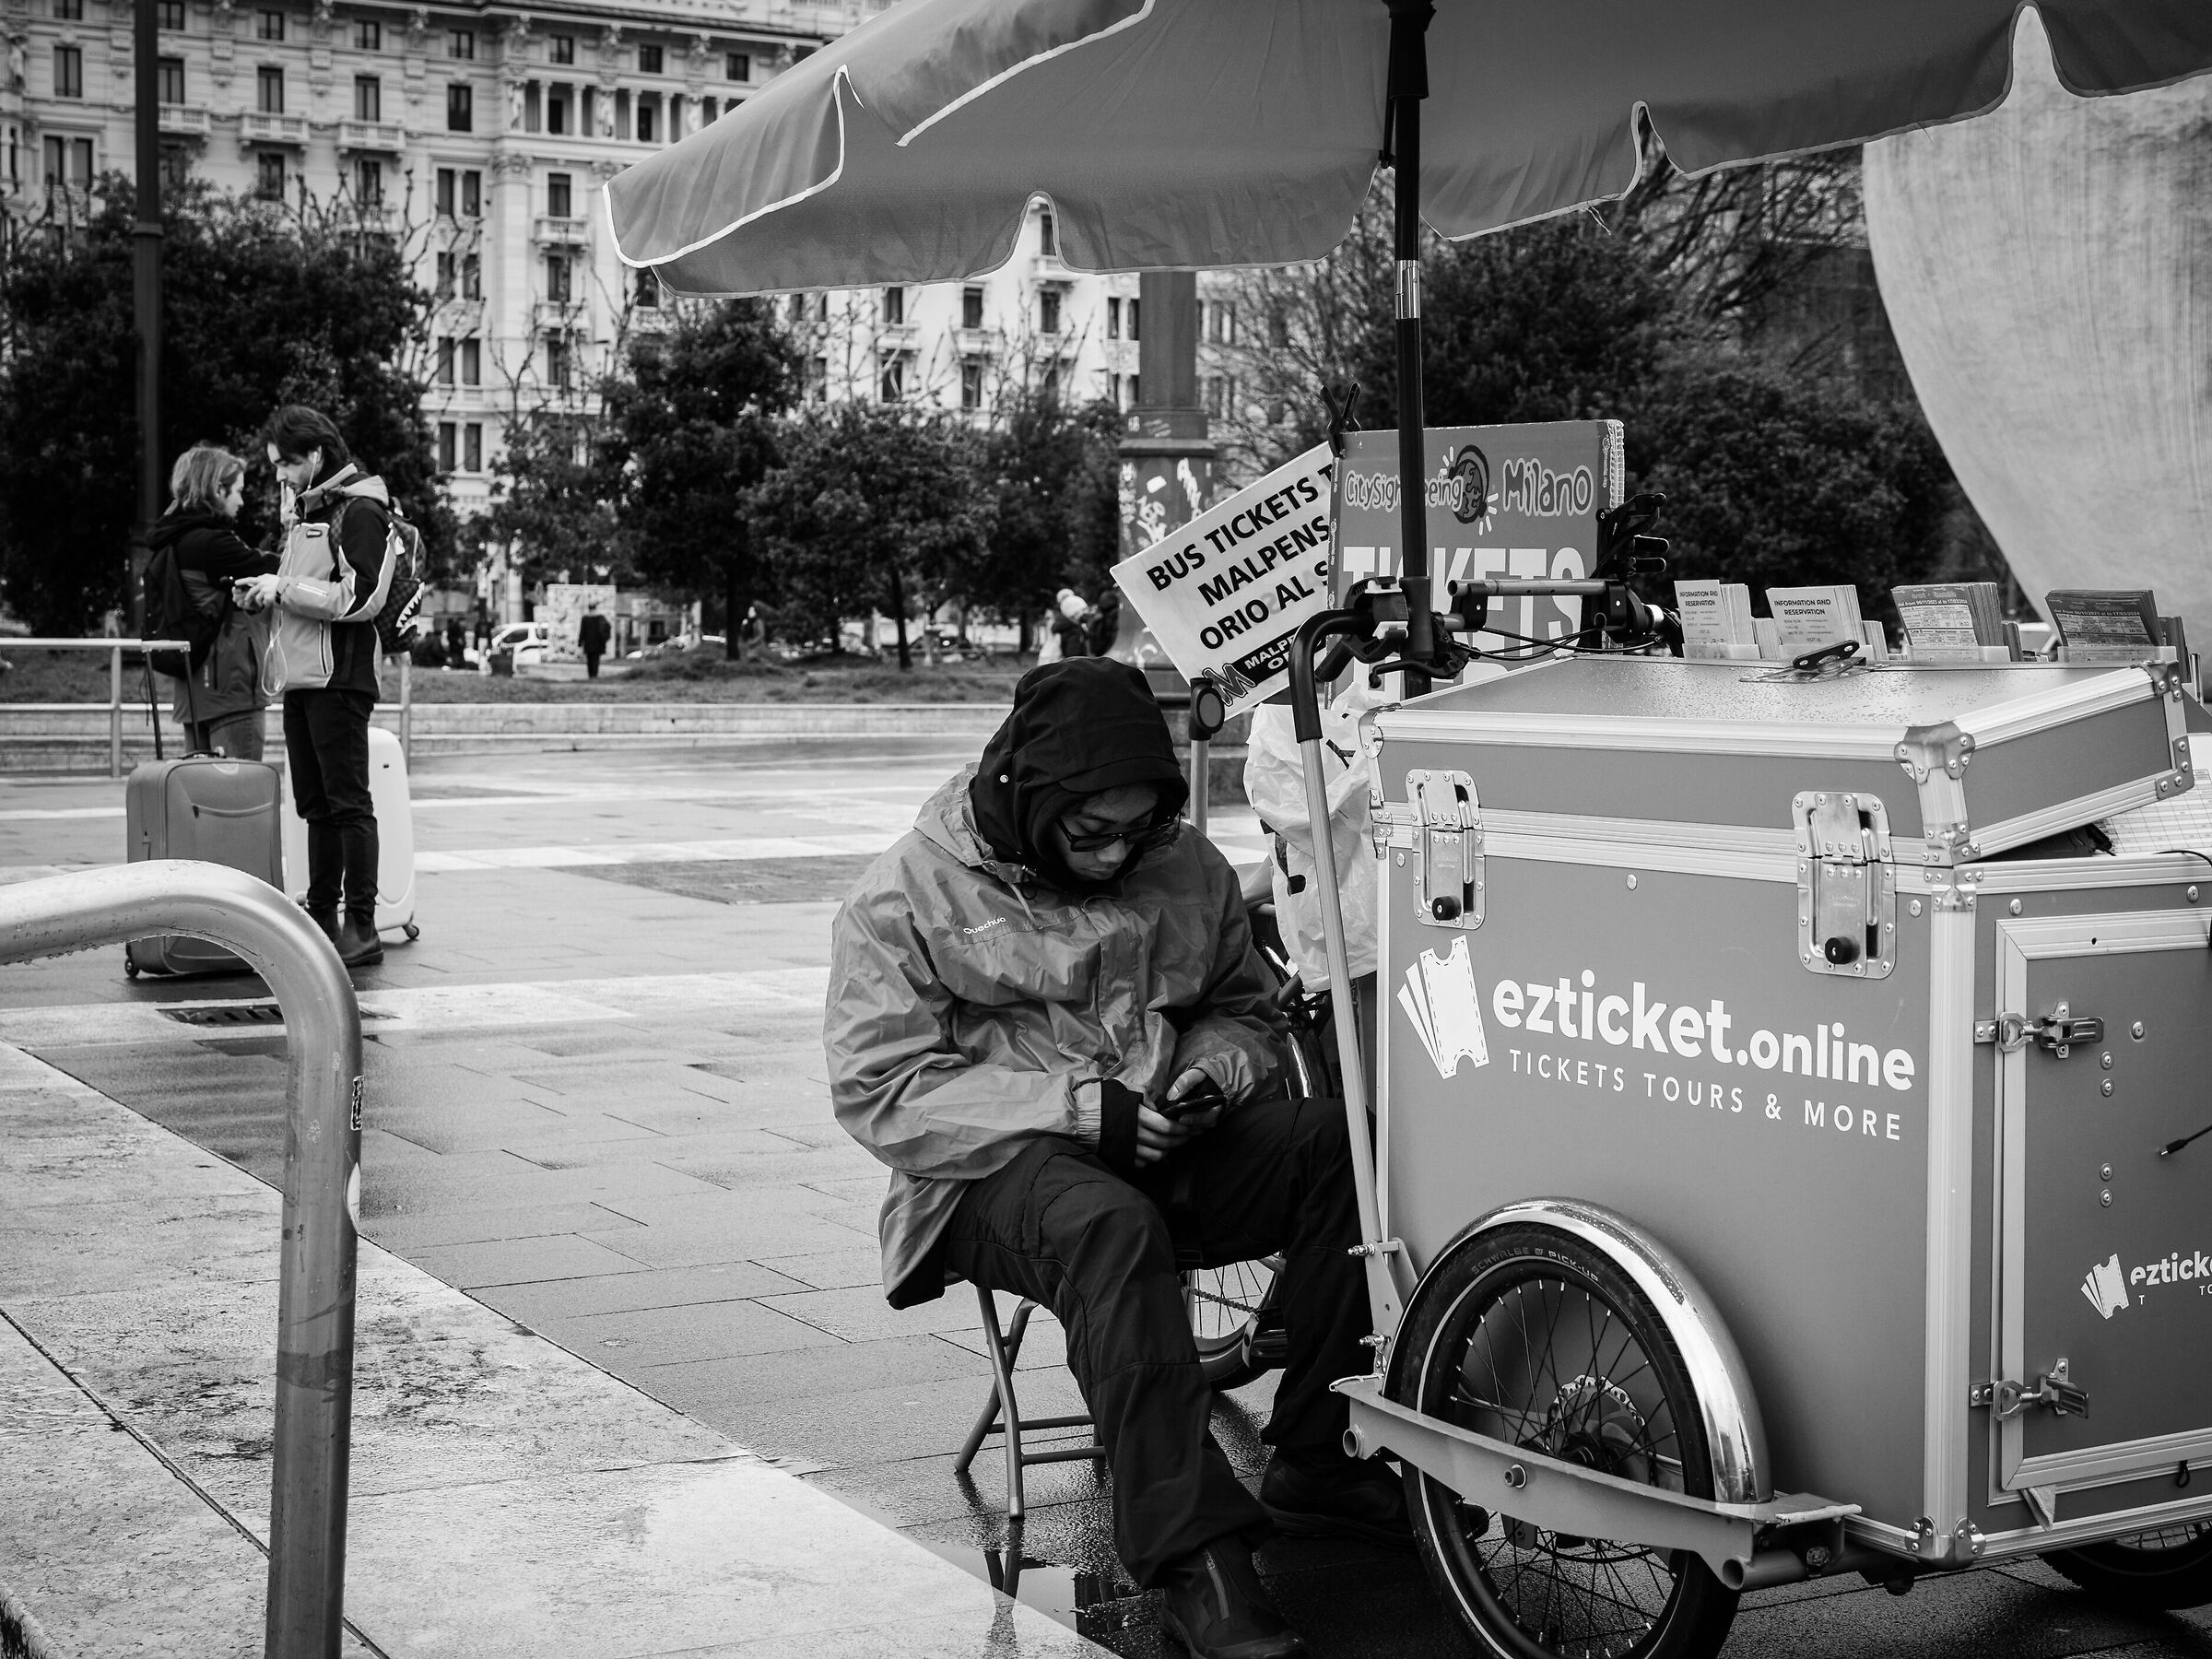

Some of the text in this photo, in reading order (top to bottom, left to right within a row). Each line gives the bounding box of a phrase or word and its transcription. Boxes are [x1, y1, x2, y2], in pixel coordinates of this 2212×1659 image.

[1503, 457, 1594, 516] Milano
[1146, 543, 1206, 592] BUS
[1204, 477, 1319, 554] TICKETS
[1200, 599, 1269, 650] ORIO
[1276, 575, 1315, 611] AL
[1343, 547, 1585, 659] TIKETS
[963, 916, 1006, 935] Quechua
[1492, 969, 1915, 1091] ezticket.online
[1509, 1049, 1900, 1141] TICKETS TOURS & MORE
[1470, 1247, 1599, 1282] SCHWALBE PICK-UP
[2130, 1251, 2212, 1286] eztick
